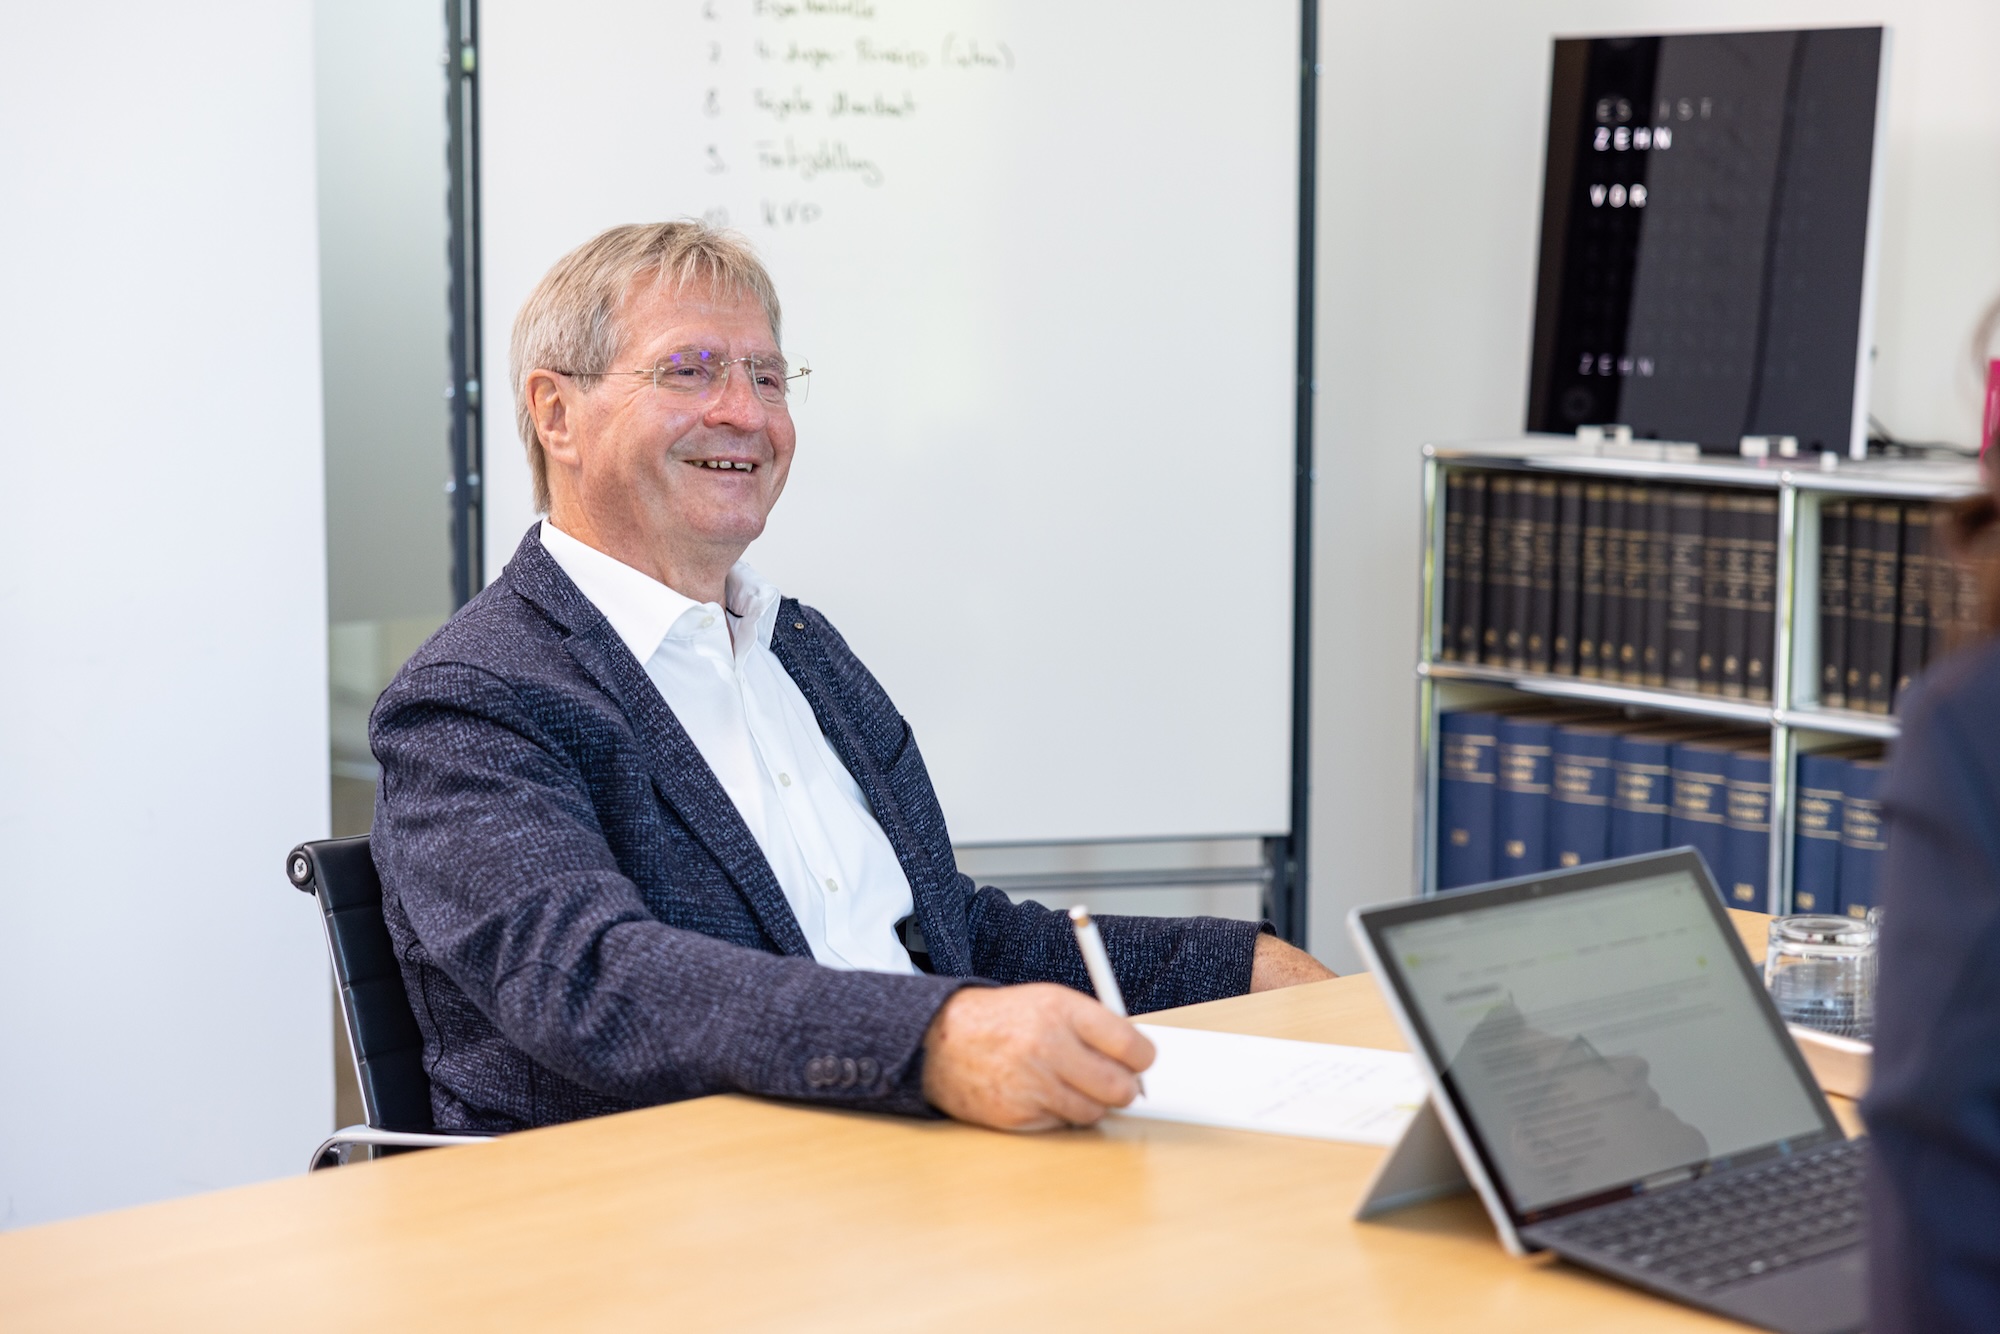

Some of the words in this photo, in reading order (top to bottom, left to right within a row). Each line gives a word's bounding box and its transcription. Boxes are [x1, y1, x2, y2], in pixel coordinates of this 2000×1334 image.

[1596, 98, 1633, 123] ES
[1593, 123, 1673, 151] ZEHN
[1589, 183, 1648, 208] VOR
[1579, 352, 1655, 377] ZEHN
